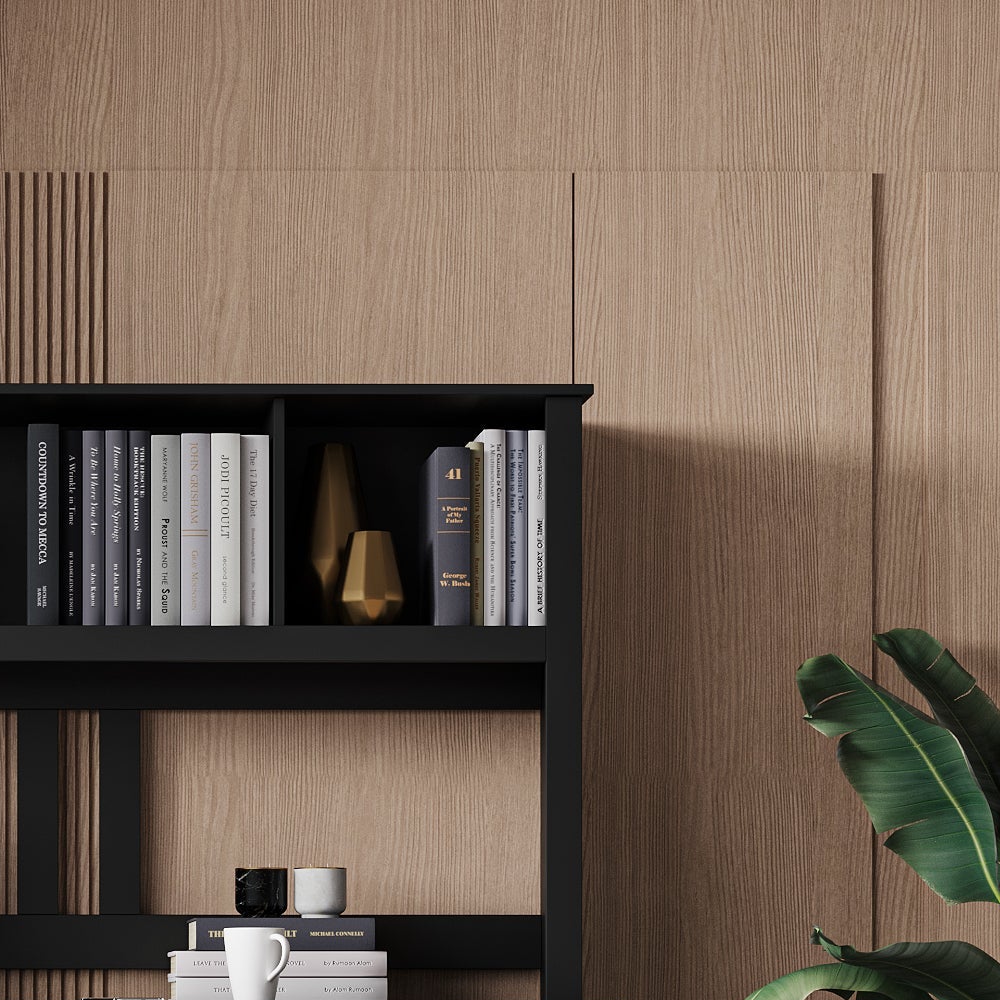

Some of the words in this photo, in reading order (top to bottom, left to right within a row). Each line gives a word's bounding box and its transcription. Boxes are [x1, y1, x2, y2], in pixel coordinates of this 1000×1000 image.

[90, 446, 98, 457] To
[113, 446, 121, 471] Home
[190, 442, 199, 471] JOHN
[249, 449, 257, 466] The
[38, 442, 47, 509] COUNTDOWN
[90, 460, 98, 471] Be
[220, 454, 230, 482] JODI
[249, 469, 257, 477] 17
[445, 468, 462, 480] 41
[68, 464, 76, 494] Wrinkle
[90, 473, 98, 500] Where
[113, 473, 121, 481] to
[112, 483, 121, 508] Holly
[190, 474, 199, 524] GRISHAM
[248, 481, 257, 497] Day
[38, 512, 47, 526] TO
[90, 502, 98, 517] You
[220, 487, 230, 539] PICOULT
[249, 500, 257, 517] Diet
[90, 520, 98, 536] Are
[112, 510, 121, 543] Springs
[161, 518, 170, 548] PROUST
[473, 514, 481, 544] Squeeze
[38, 528, 47, 564] MECCA
[537, 539, 543, 549] OF
[161, 551, 169, 568] AND
[161, 572, 169, 585] THE
[161, 588, 170, 614] SQUID
